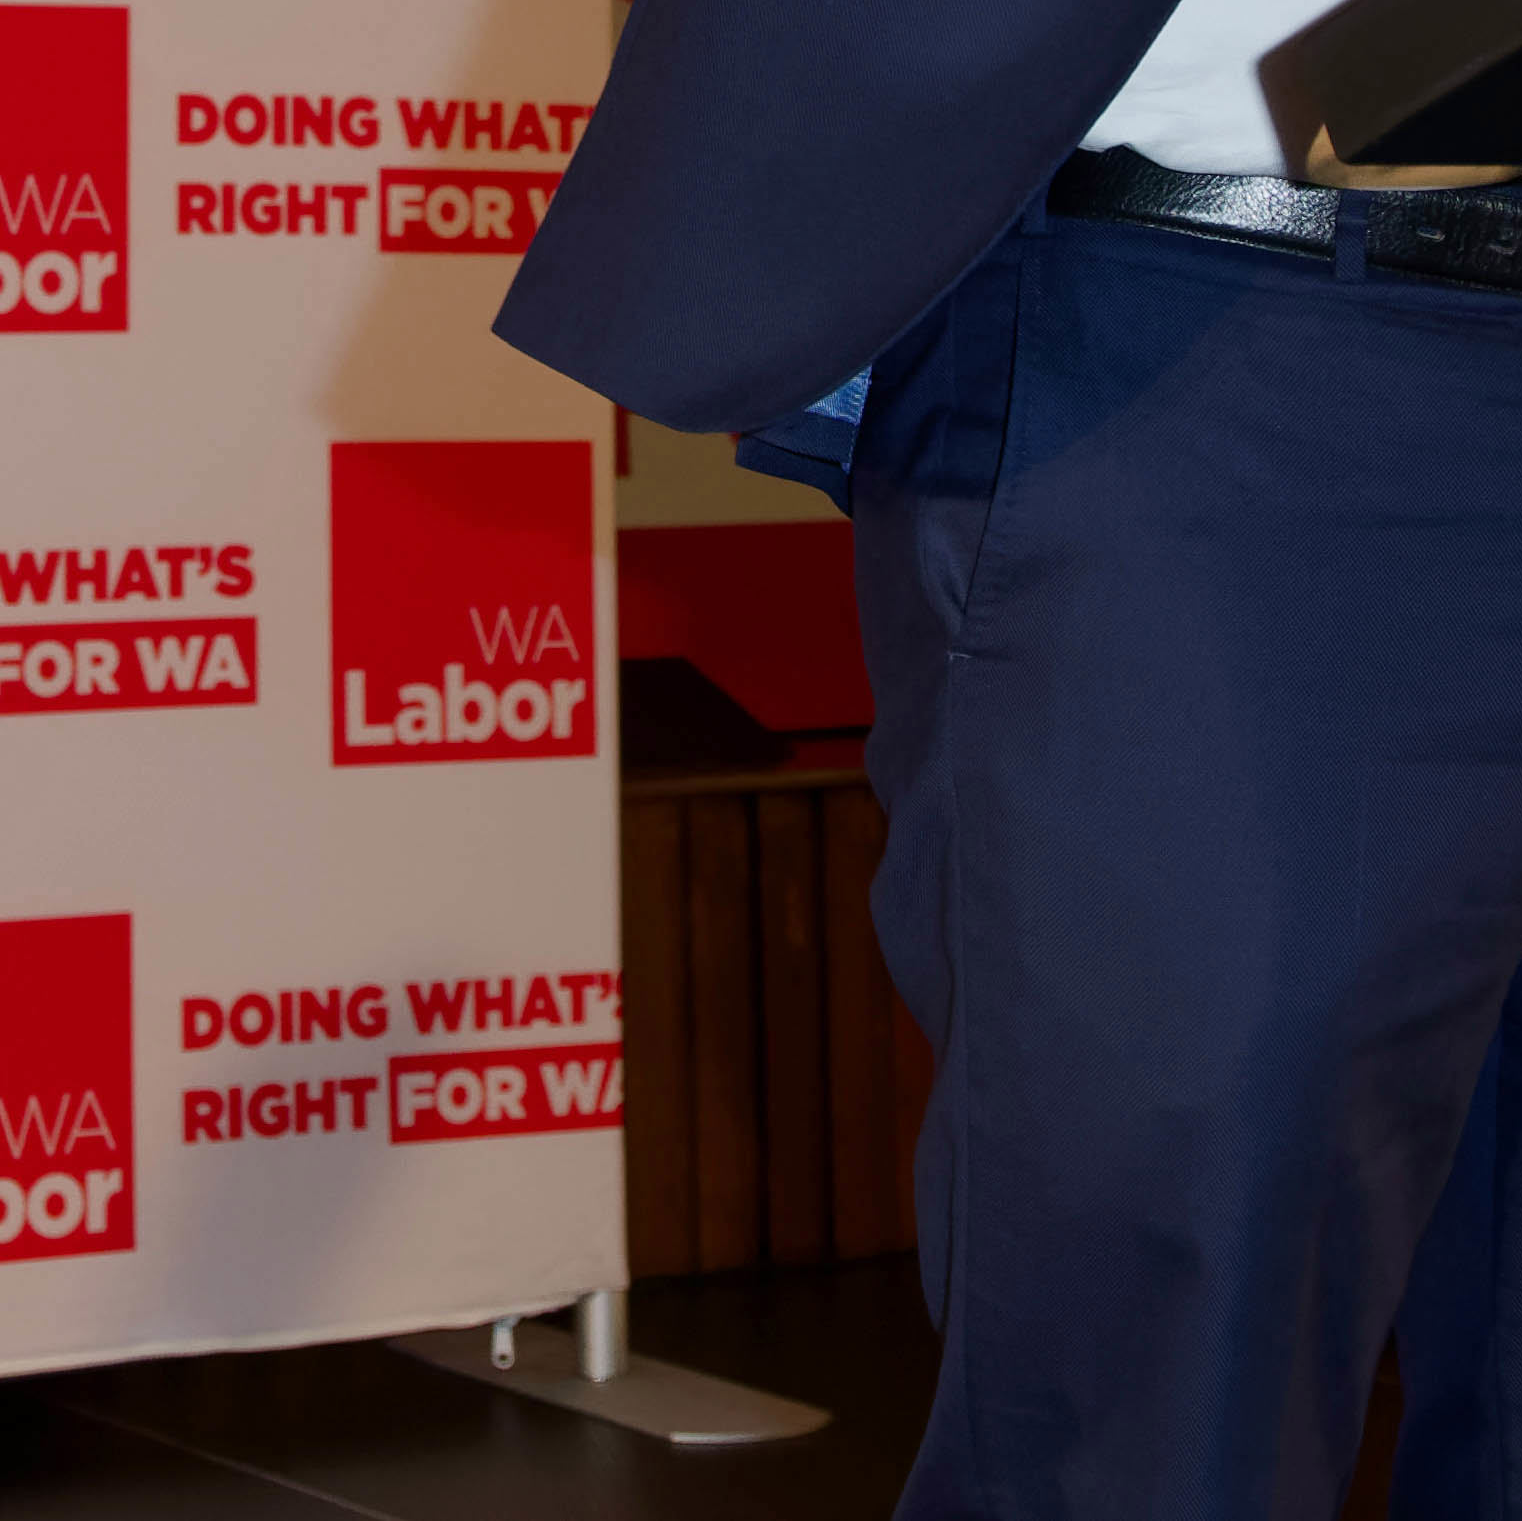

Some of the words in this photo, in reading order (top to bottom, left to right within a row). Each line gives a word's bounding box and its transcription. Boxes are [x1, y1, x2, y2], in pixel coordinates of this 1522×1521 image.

[177, 92, 380, 149] DOING
[397, 97, 597, 155] WHAT
[0, 173, 112, 236] WA
[177, 180, 369, 236] RIGHT
[386, 183, 516, 240] FOR
[0, 543, 254, 606] WHAT'S
[134, 633, 250, 694] WA
[469, 604, 580, 665] WA
[344, 662, 587, 747] Labor
[181, 983, 389, 1051] DOING
[405, 972, 623, 1037] WHAT'
[0, 1088, 116, 1160] WA
[181, 1075, 380, 1144] RIGHT
[397, 1066, 527, 1129] FOR
